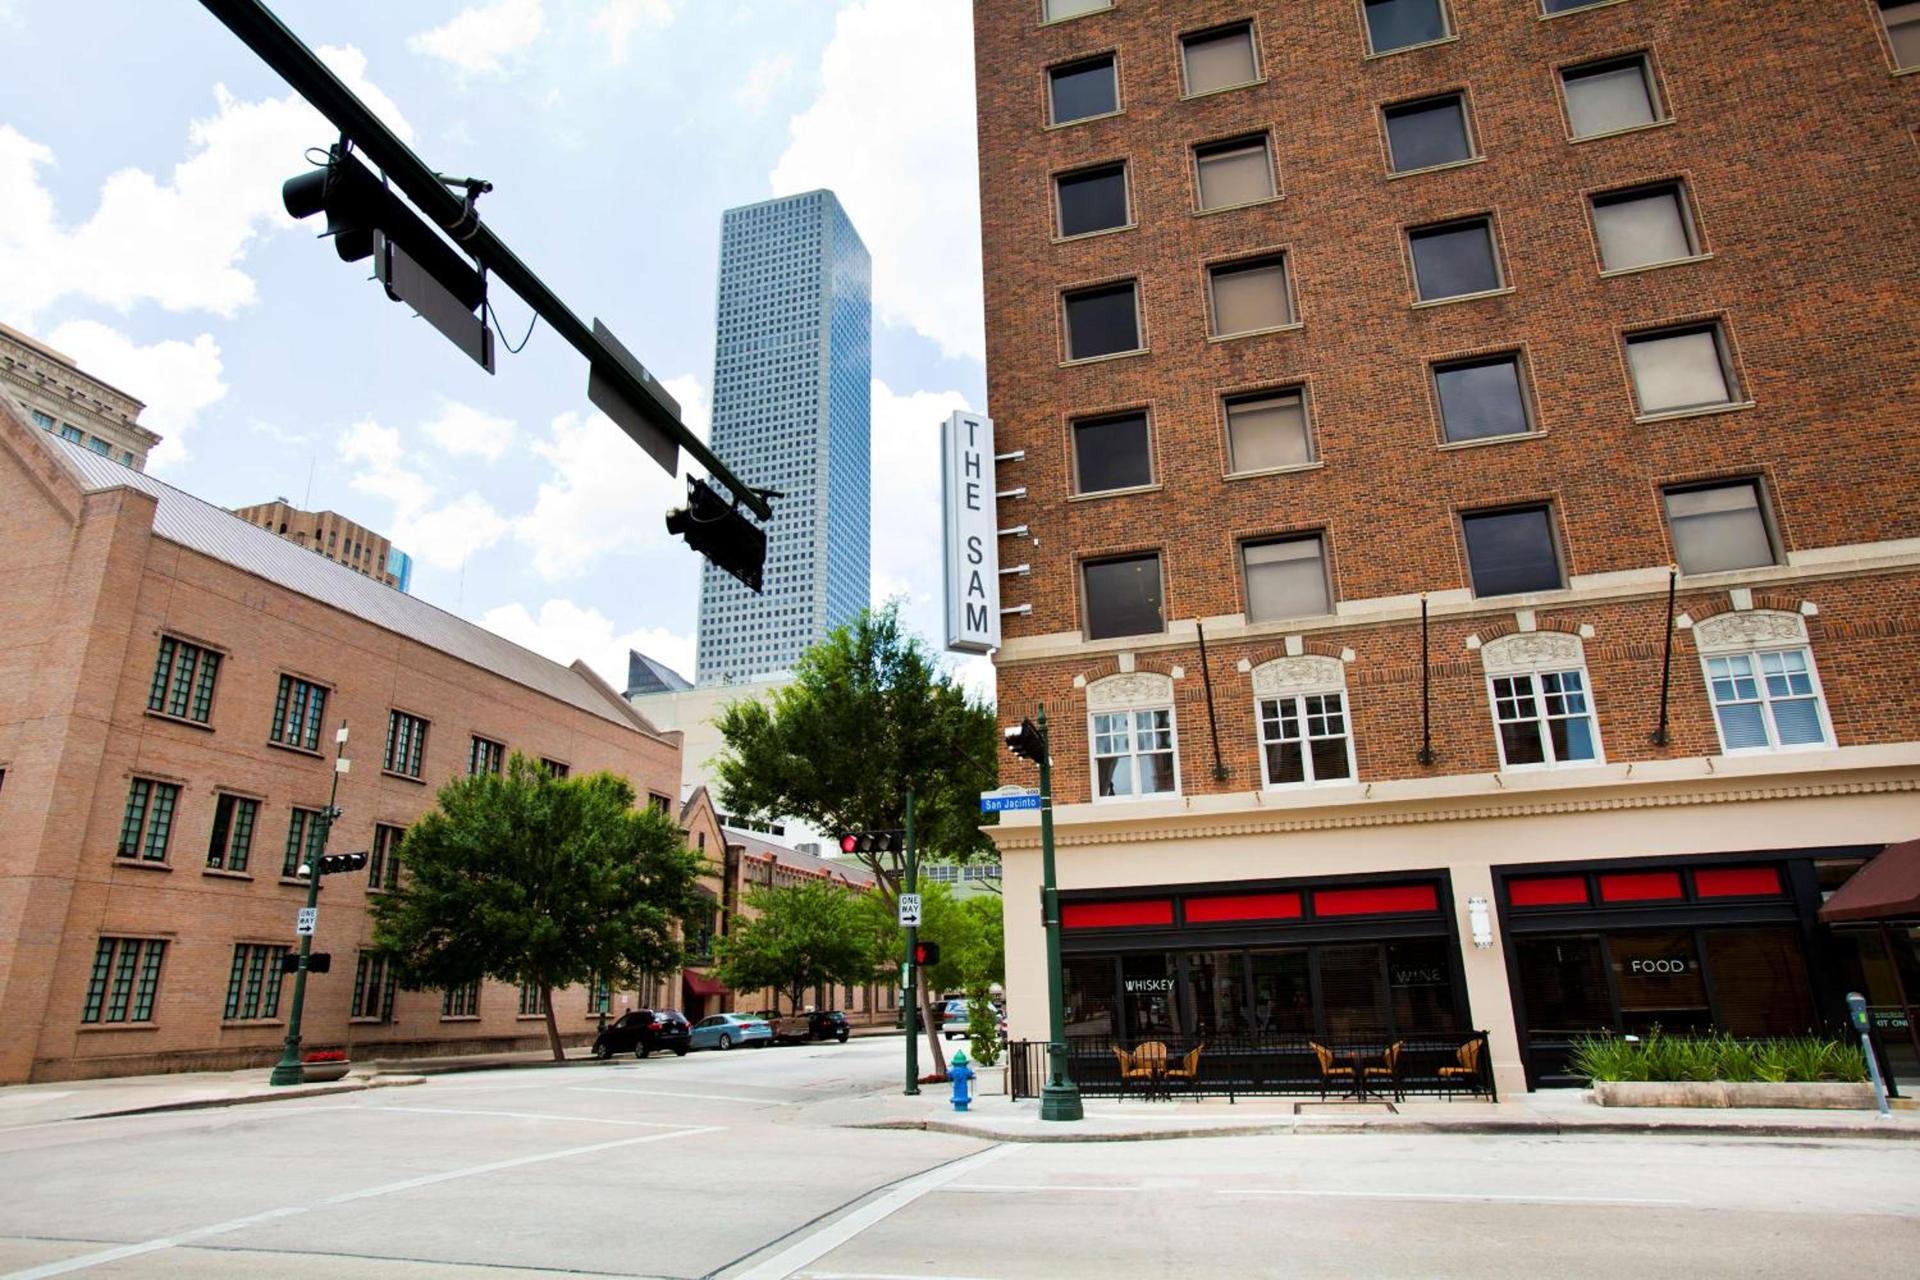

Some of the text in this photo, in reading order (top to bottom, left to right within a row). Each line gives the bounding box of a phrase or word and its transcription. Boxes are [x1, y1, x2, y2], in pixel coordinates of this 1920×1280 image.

[964, 420, 988, 633] THE SAM
[985, 797, 1036, 811] San Jacinto
[902, 896, 919, 904] ONE
[301, 909, 315, 917] ONE
[902, 905, 919, 913] WAY
[1632, 960, 1684, 973] FOOD
[1125, 979, 1175, 991] WHISKEY
